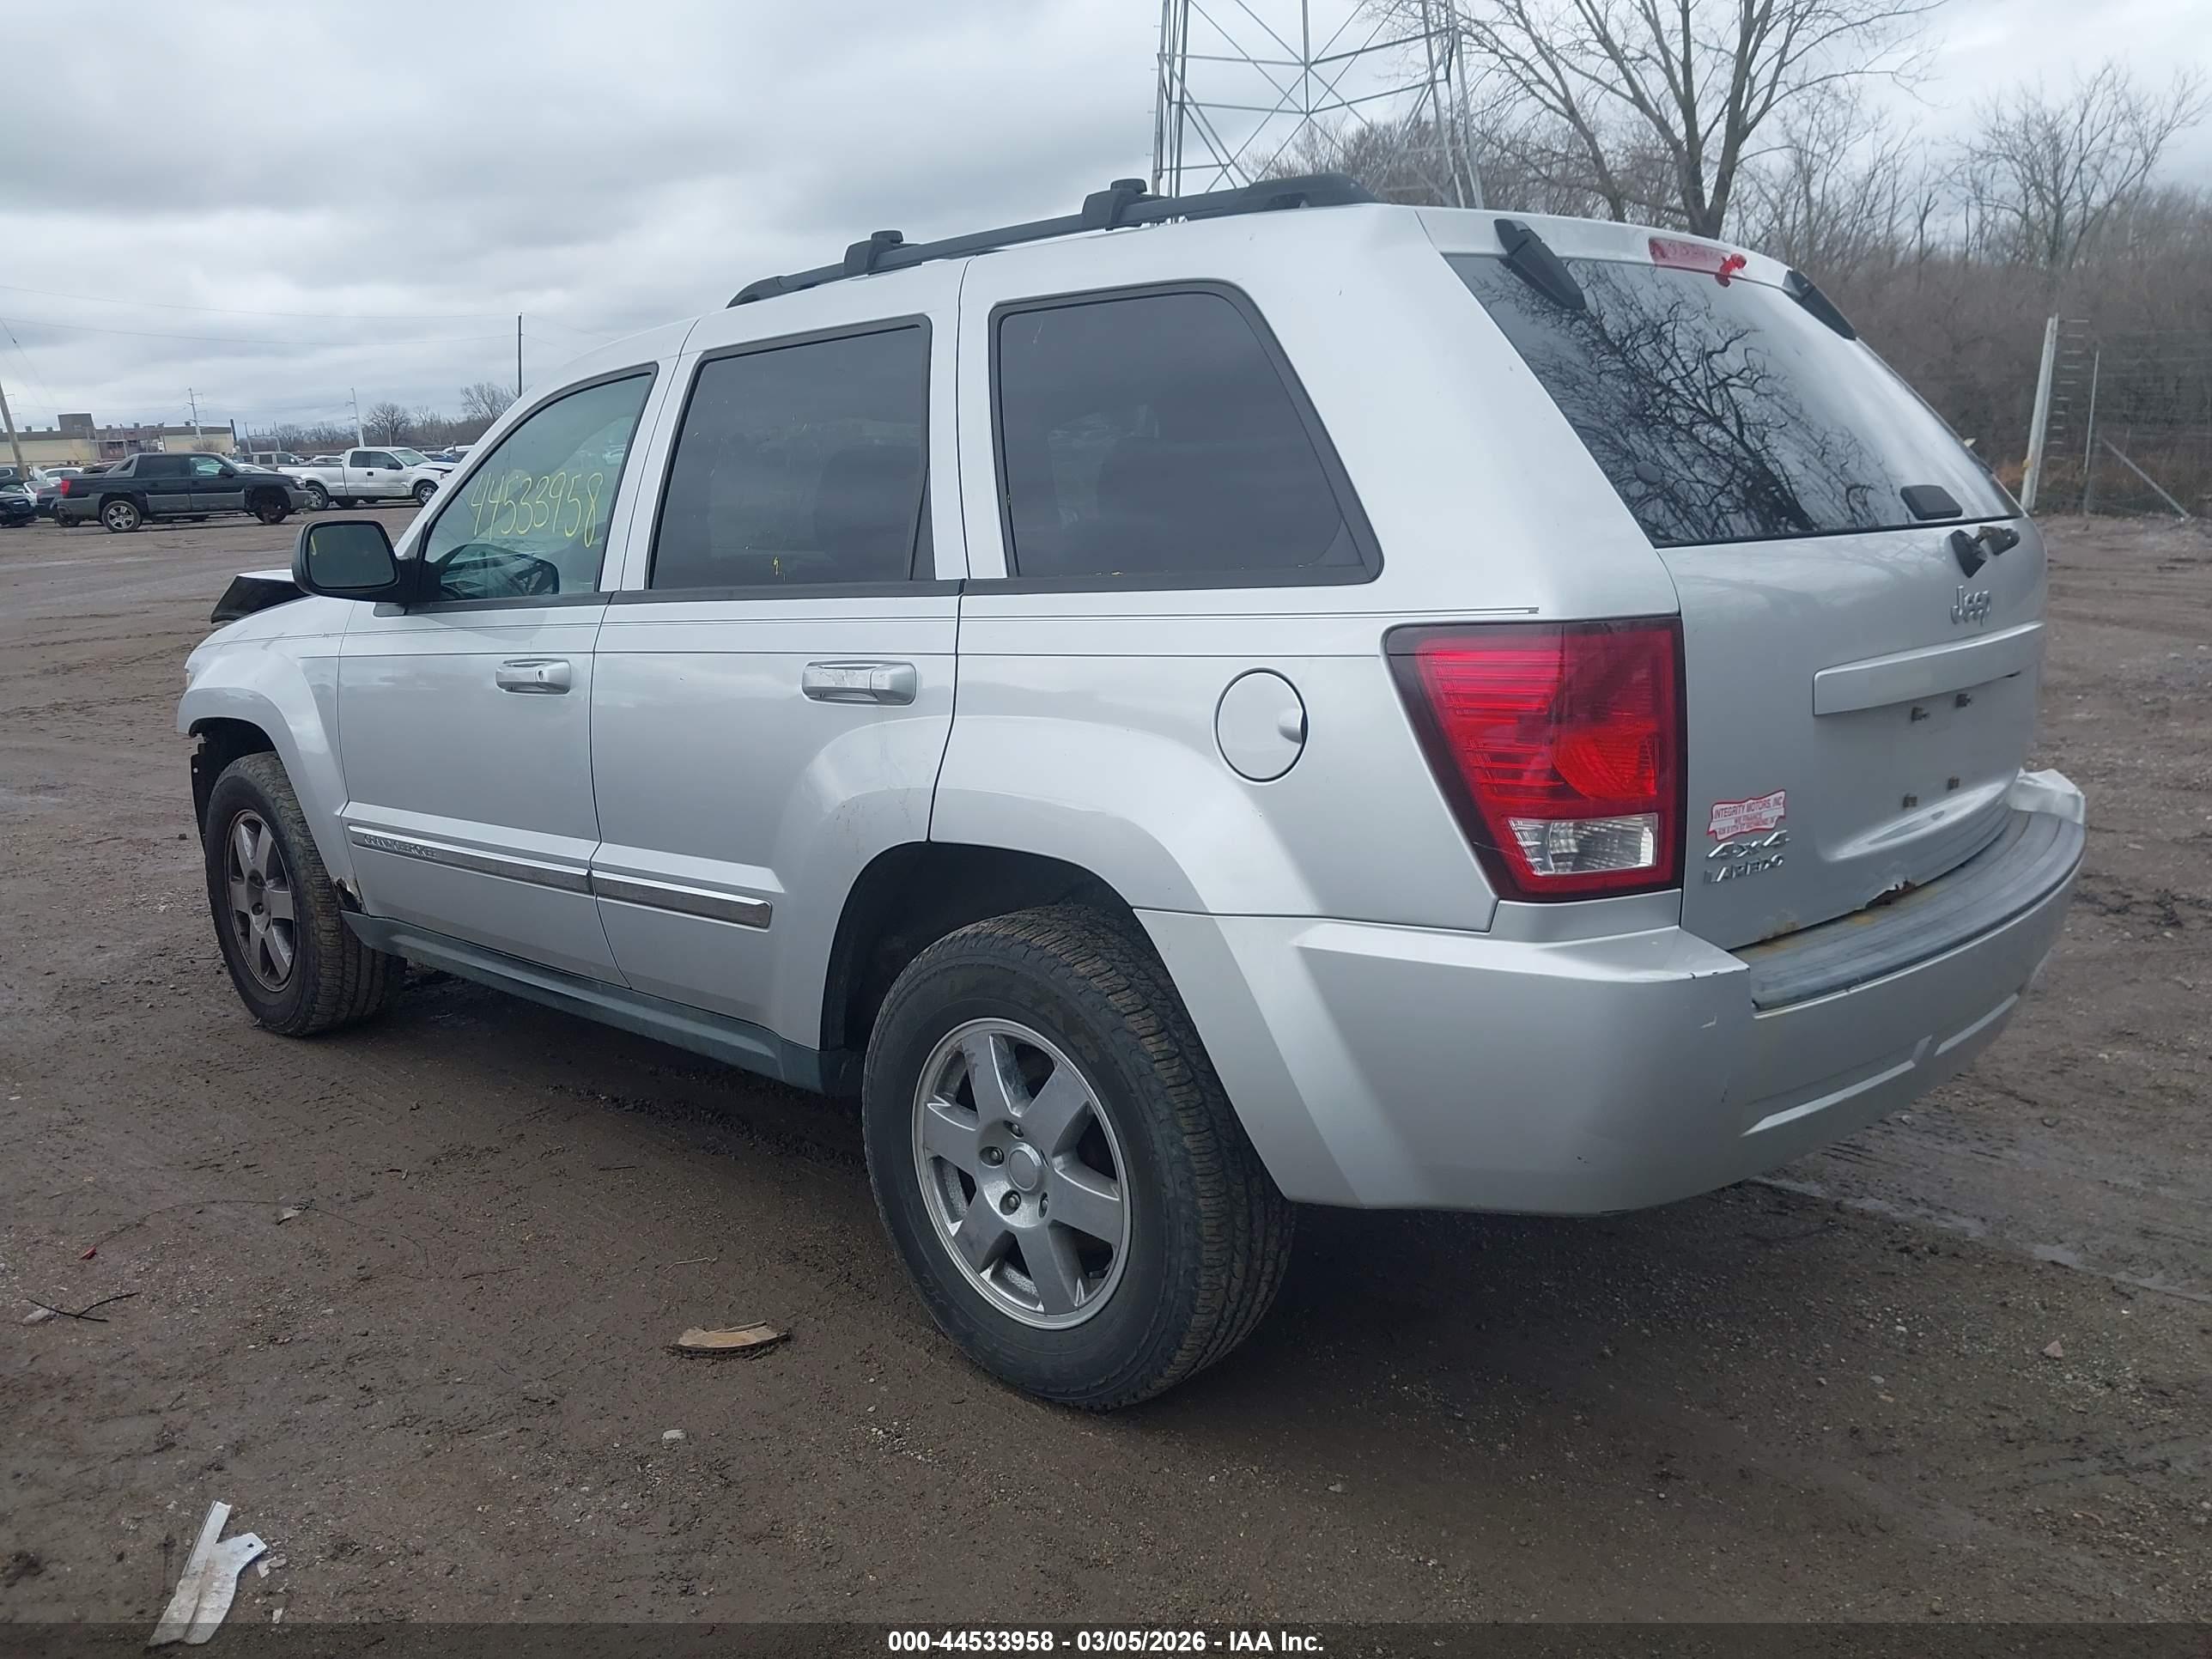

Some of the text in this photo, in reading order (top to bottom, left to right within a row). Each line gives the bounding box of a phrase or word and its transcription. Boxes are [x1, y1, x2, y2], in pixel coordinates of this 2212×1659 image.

[471, 471, 604, 548] 44533958
[1950, 585, 1990, 626] Jeep
[1714, 805, 1747, 819] INTEGRITY
[1704, 854, 1784, 884] LAREDO
